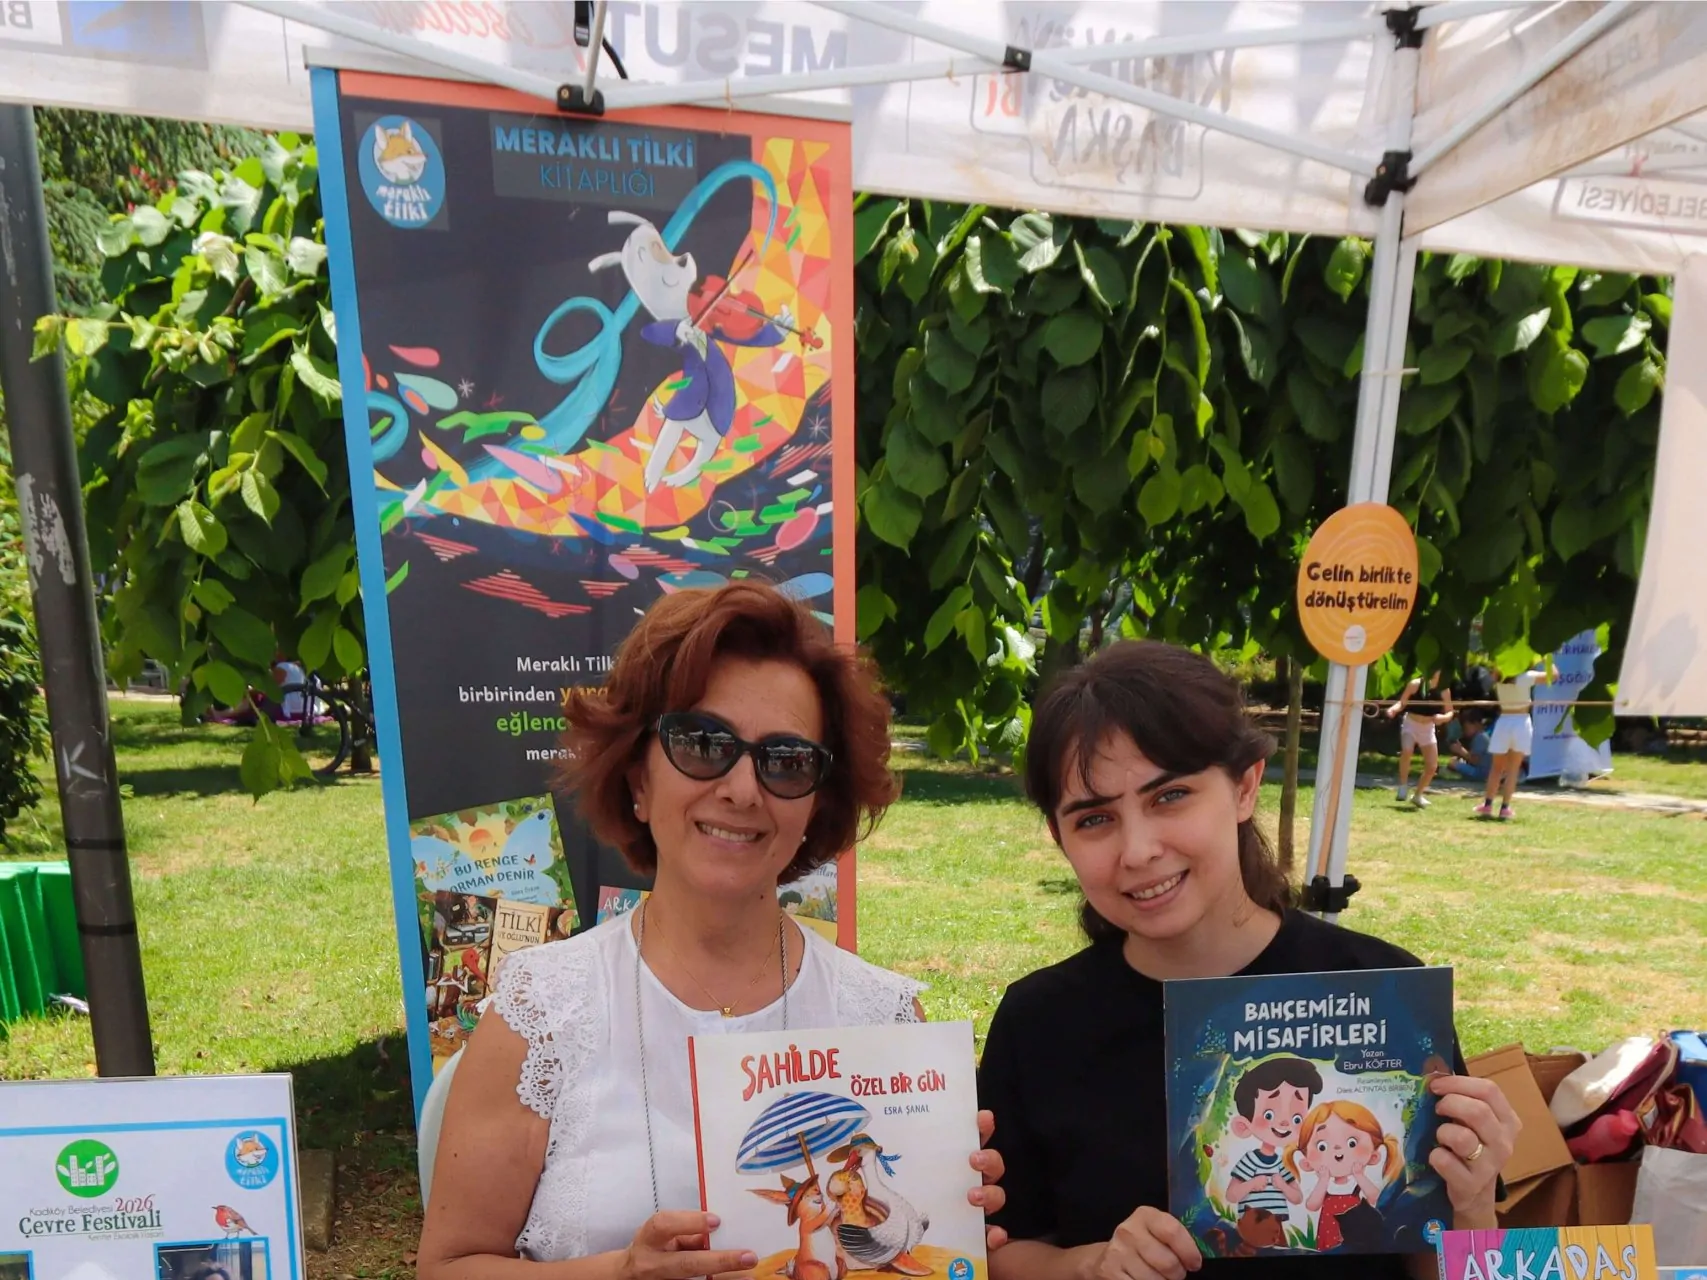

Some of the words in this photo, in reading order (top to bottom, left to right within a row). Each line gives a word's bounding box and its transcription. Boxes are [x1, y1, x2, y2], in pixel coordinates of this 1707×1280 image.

[494, 126, 621, 161] MERAKLI
[626, 132, 696, 168] TİLKİ
[540, 162, 656, 198] KİTAPLIĞI
[1306, 562, 1354, 582] Gelin
[1358, 564, 1413, 585] birlikte
[1305, 590, 1409, 613] dönüştürelim
[516, 656, 581, 672] Meraklı
[585, 656, 621, 672] Tilk
[458, 686, 556, 703] birbirinden
[496, 711, 569, 737] eğlenc
[454, 864, 472, 877] BU
[474, 854, 519, 870] RENGE
[450, 875, 495, 893] ORMAN
[497, 868, 535, 884] DENİR
[499, 911, 544, 934] TİLKİ
[1244, 992, 1371, 1022] BAHÇEMİZİN
[1233, 1019, 1387, 1052] MİSAFİRLERİ
[741, 1044, 843, 1101] SAHİLDE
[1365, 1059, 1402, 1069] KÖFTER
[850, 1074, 887, 1097] ÖZEL
[890, 1072, 913, 1095] BİR
[917, 1069, 946, 1093] GÜN
[884, 1105, 903, 1116] ESRA
[905, 1103, 931, 1117] ŞANAL
[115, 1194, 156, 1213] 2026
[18, 1214, 77, 1238] Çevre
[82, 1209, 162, 1232] Festivali
